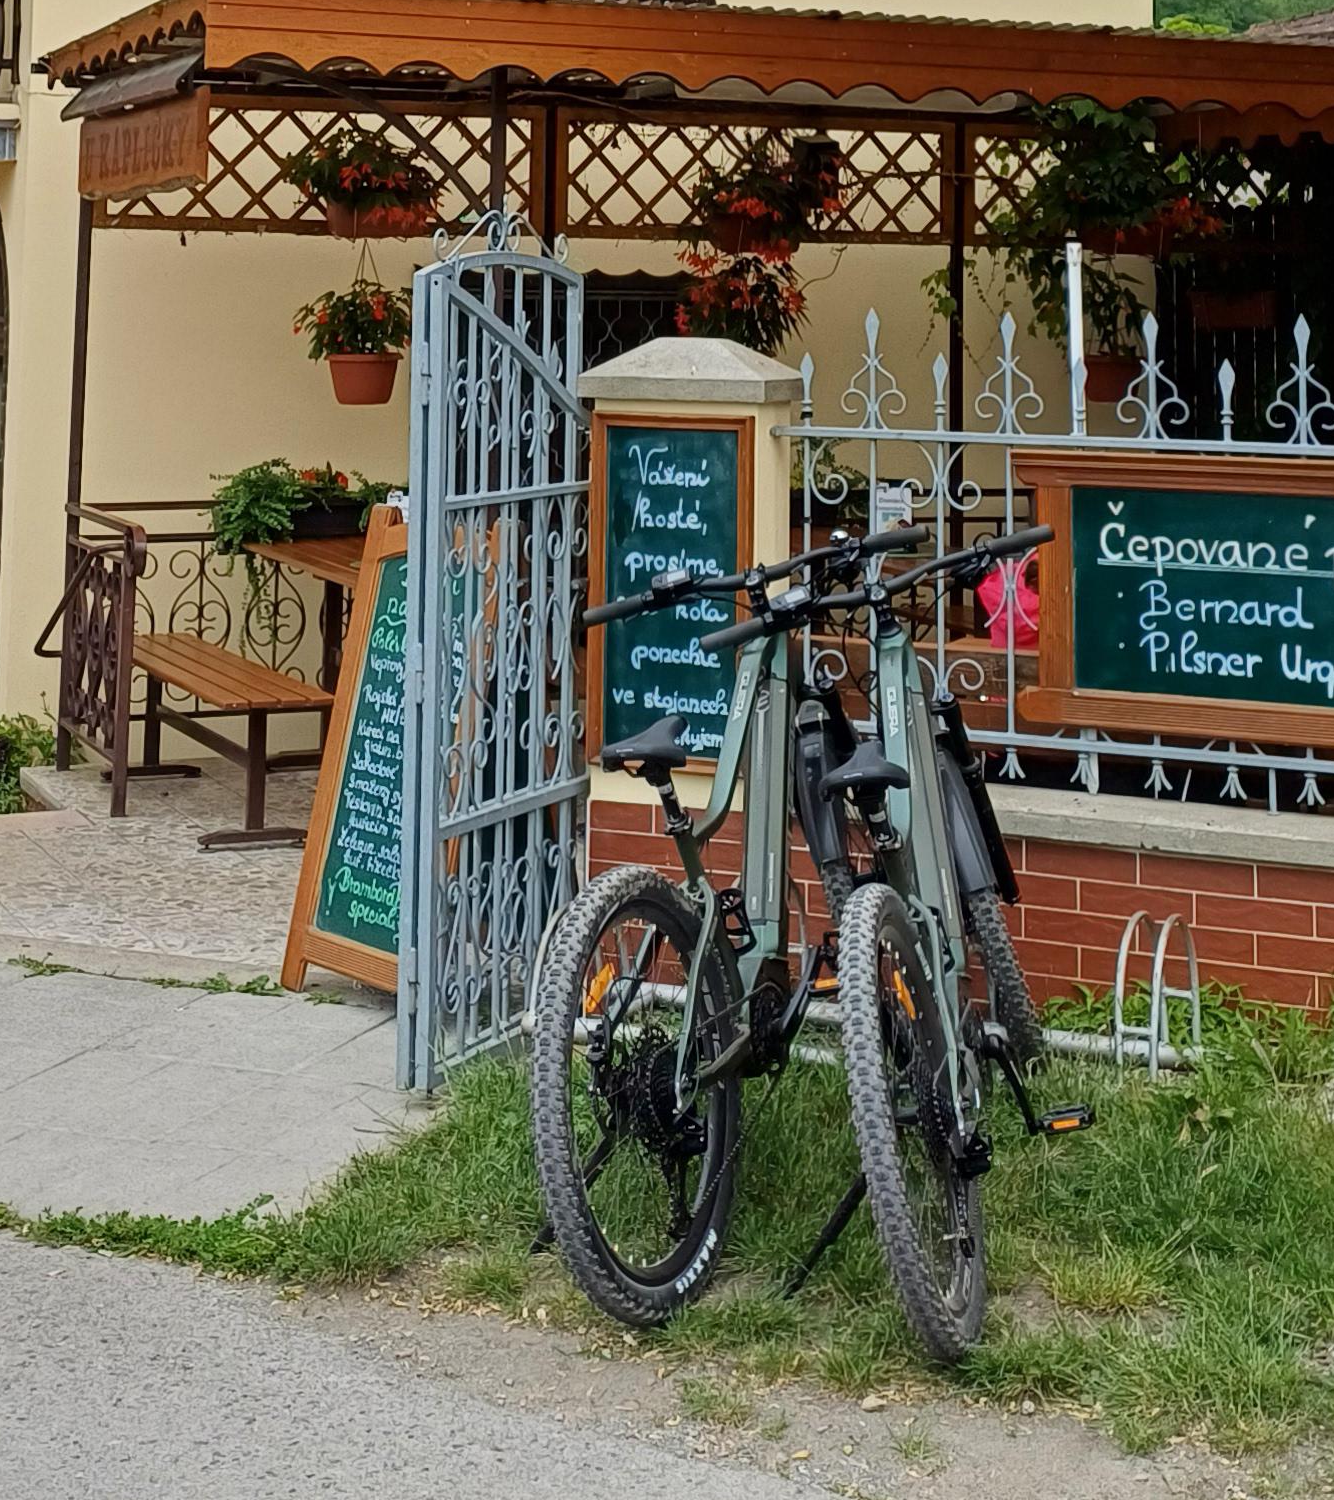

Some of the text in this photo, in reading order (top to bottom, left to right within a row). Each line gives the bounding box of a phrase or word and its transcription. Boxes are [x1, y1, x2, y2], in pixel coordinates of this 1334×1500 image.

[1098, 501, 1316, 577] Čepované
[1139, 579, 1314, 631] Bernard
[1139, 630, 1263, 679] Pilsner
[612, 687, 635, 704] ve
[675, 1228, 718, 1294] MAXXIS
